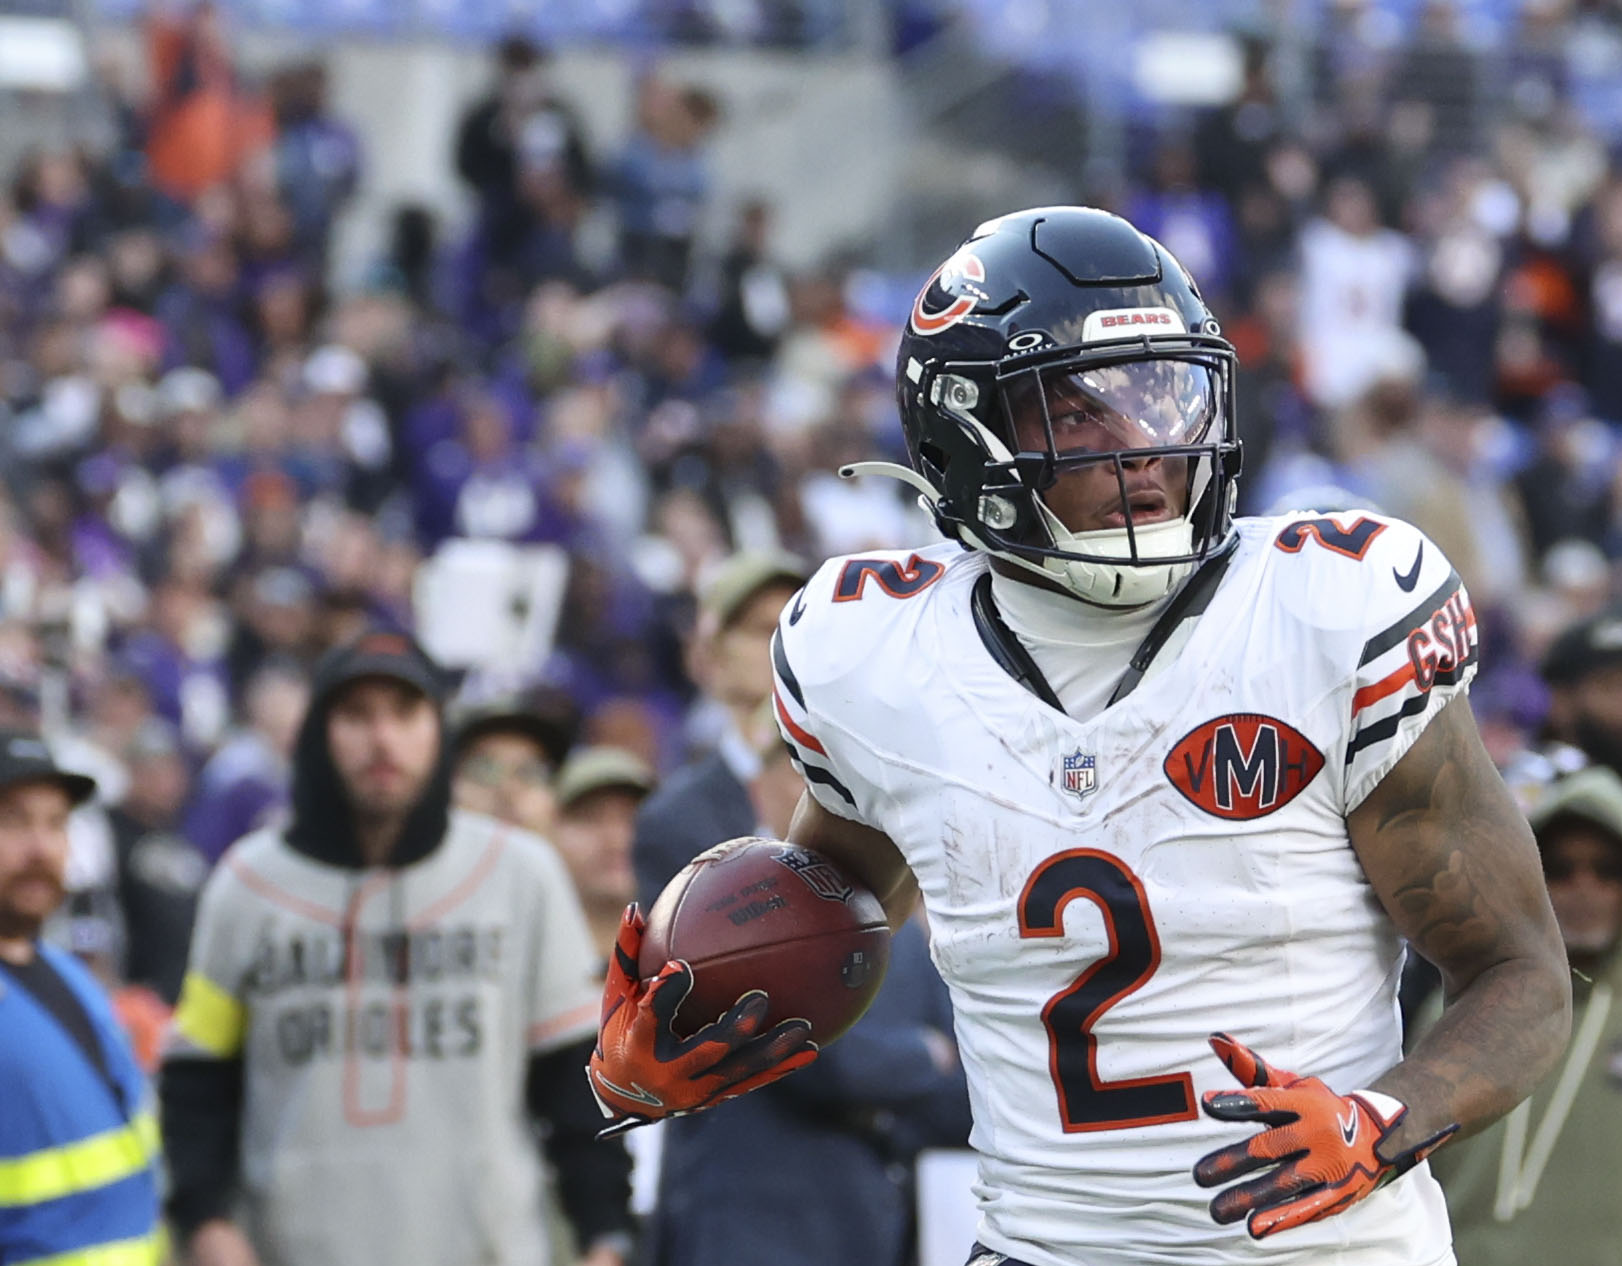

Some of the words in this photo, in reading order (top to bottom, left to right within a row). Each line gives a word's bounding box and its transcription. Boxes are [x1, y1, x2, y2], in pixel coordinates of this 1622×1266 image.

[1100, 313, 1172, 328] BEARS
[1406, 590, 1470, 693] GSH
[1065, 769, 1094, 789] NFL
[1016, 847, 1199, 1134] 2
